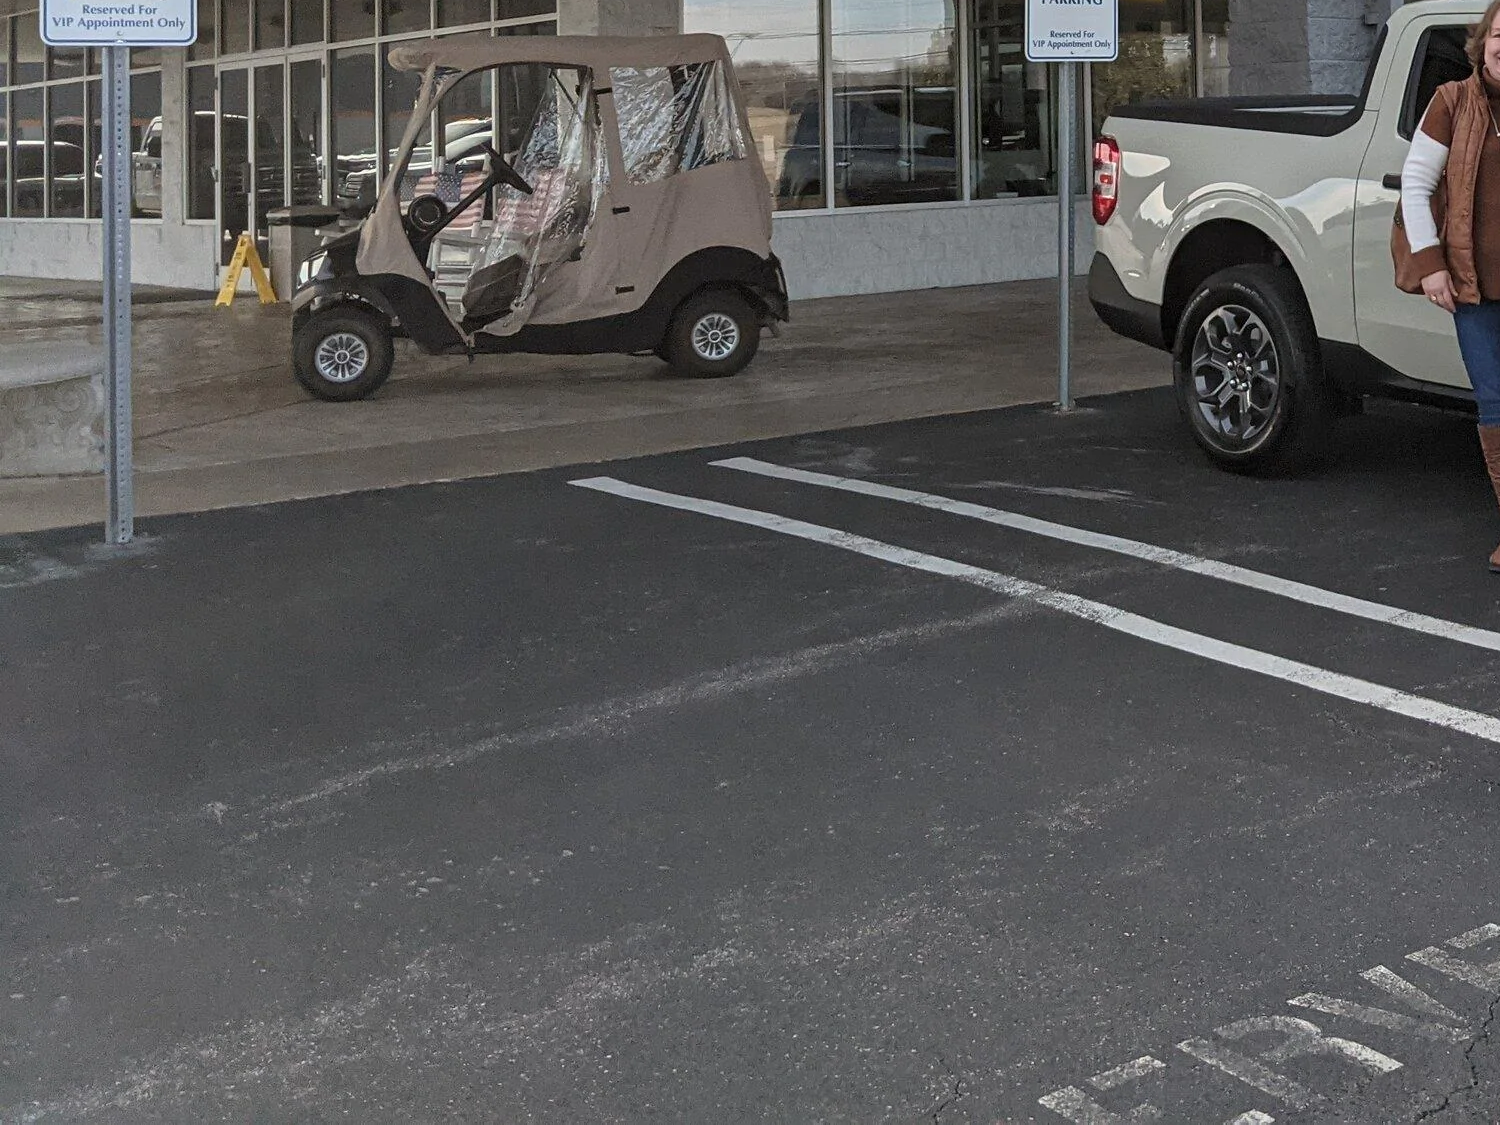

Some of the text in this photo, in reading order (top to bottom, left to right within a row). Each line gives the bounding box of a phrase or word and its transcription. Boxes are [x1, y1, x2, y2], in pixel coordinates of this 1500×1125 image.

[82, 4, 157, 15] Reserved For
[52, 17, 186, 31] VIP Appointment Only
[1050, 30, 1095, 39] Reserved For
[1032, 40, 1111, 49] VIP Appointment Only
